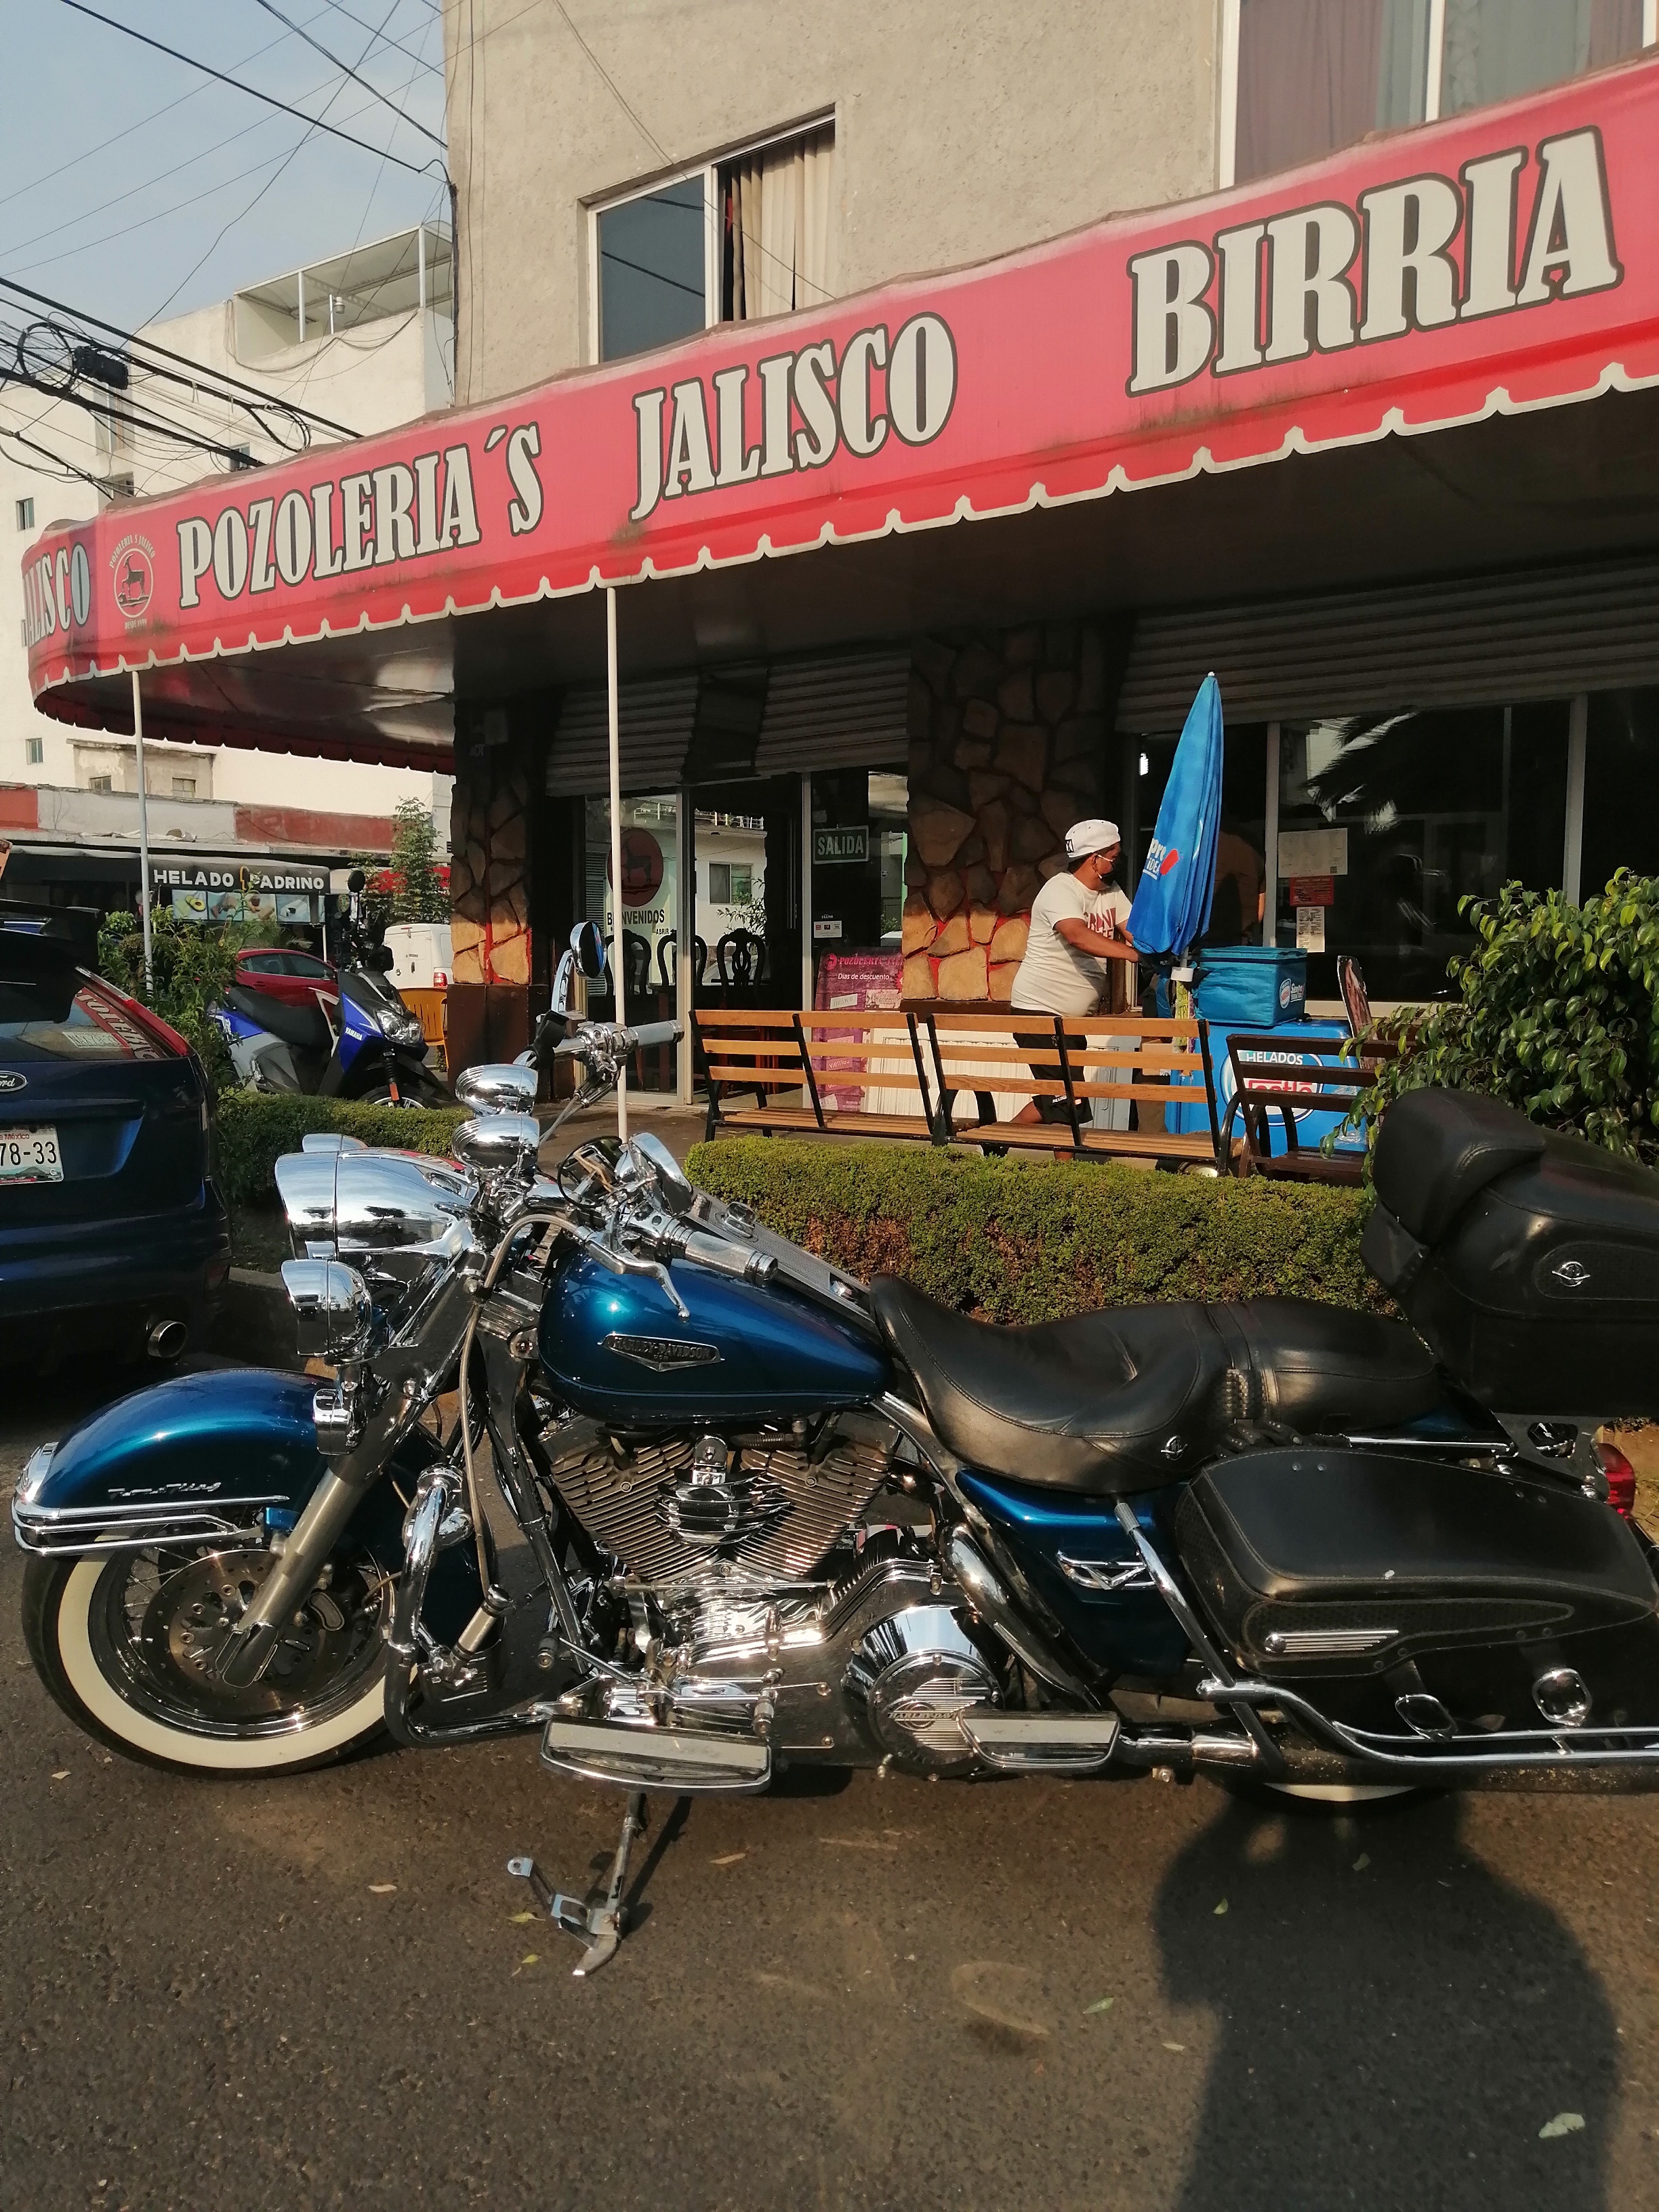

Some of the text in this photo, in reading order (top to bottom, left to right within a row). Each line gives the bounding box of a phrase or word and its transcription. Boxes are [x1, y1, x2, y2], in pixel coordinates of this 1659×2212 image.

[629, 311, 958, 525] JALISCO
[1126, 125, 1624, 398] BIRRIA
[23, 541, 91, 649] ALISCO
[817, 836, 864, 855] SALIDA
[153, 869, 234, 887] HELADO
[607, 909, 665, 926] BNVENIDOS
[345, 1026, 363, 1041] YAMAHA
[829, 1059, 850, 1069] viernes
[1246, 1051, 1304, 1065] HELADOS
